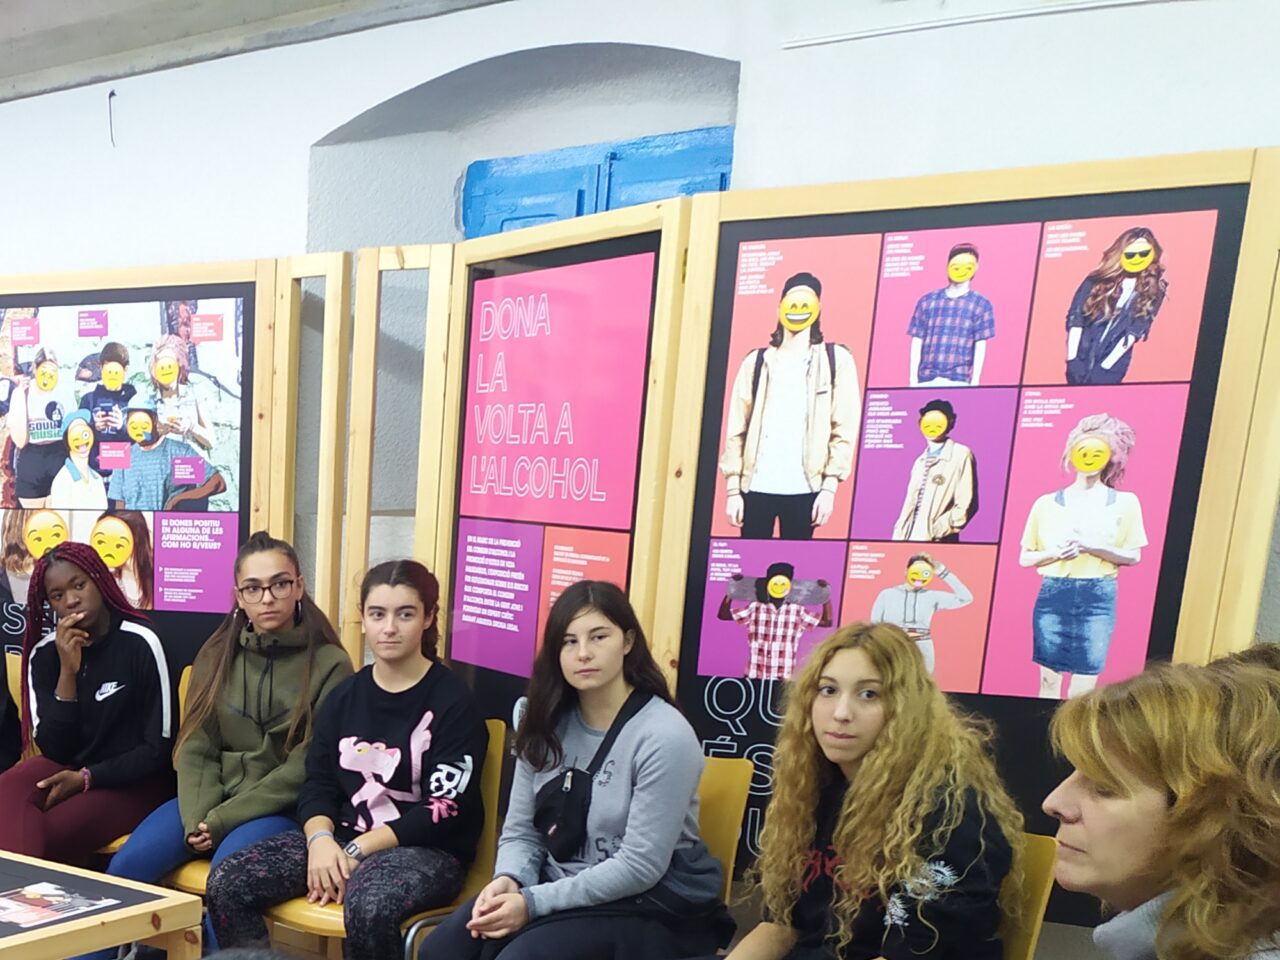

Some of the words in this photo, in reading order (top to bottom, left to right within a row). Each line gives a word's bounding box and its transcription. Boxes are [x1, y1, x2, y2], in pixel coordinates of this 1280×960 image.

[479, 293, 551, 342] DONA
[476, 352, 508, 394] LA
[474, 403, 549, 444] VOLTA
[554, 402, 574, 444] A
[470, 455, 607, 502] L'ALCOHOL
[161, 526, 171, 534] EN
[212, 527, 224, 535] LES
[194, 519, 220, 527] POSITIU
[161, 541, 179, 549] COM
